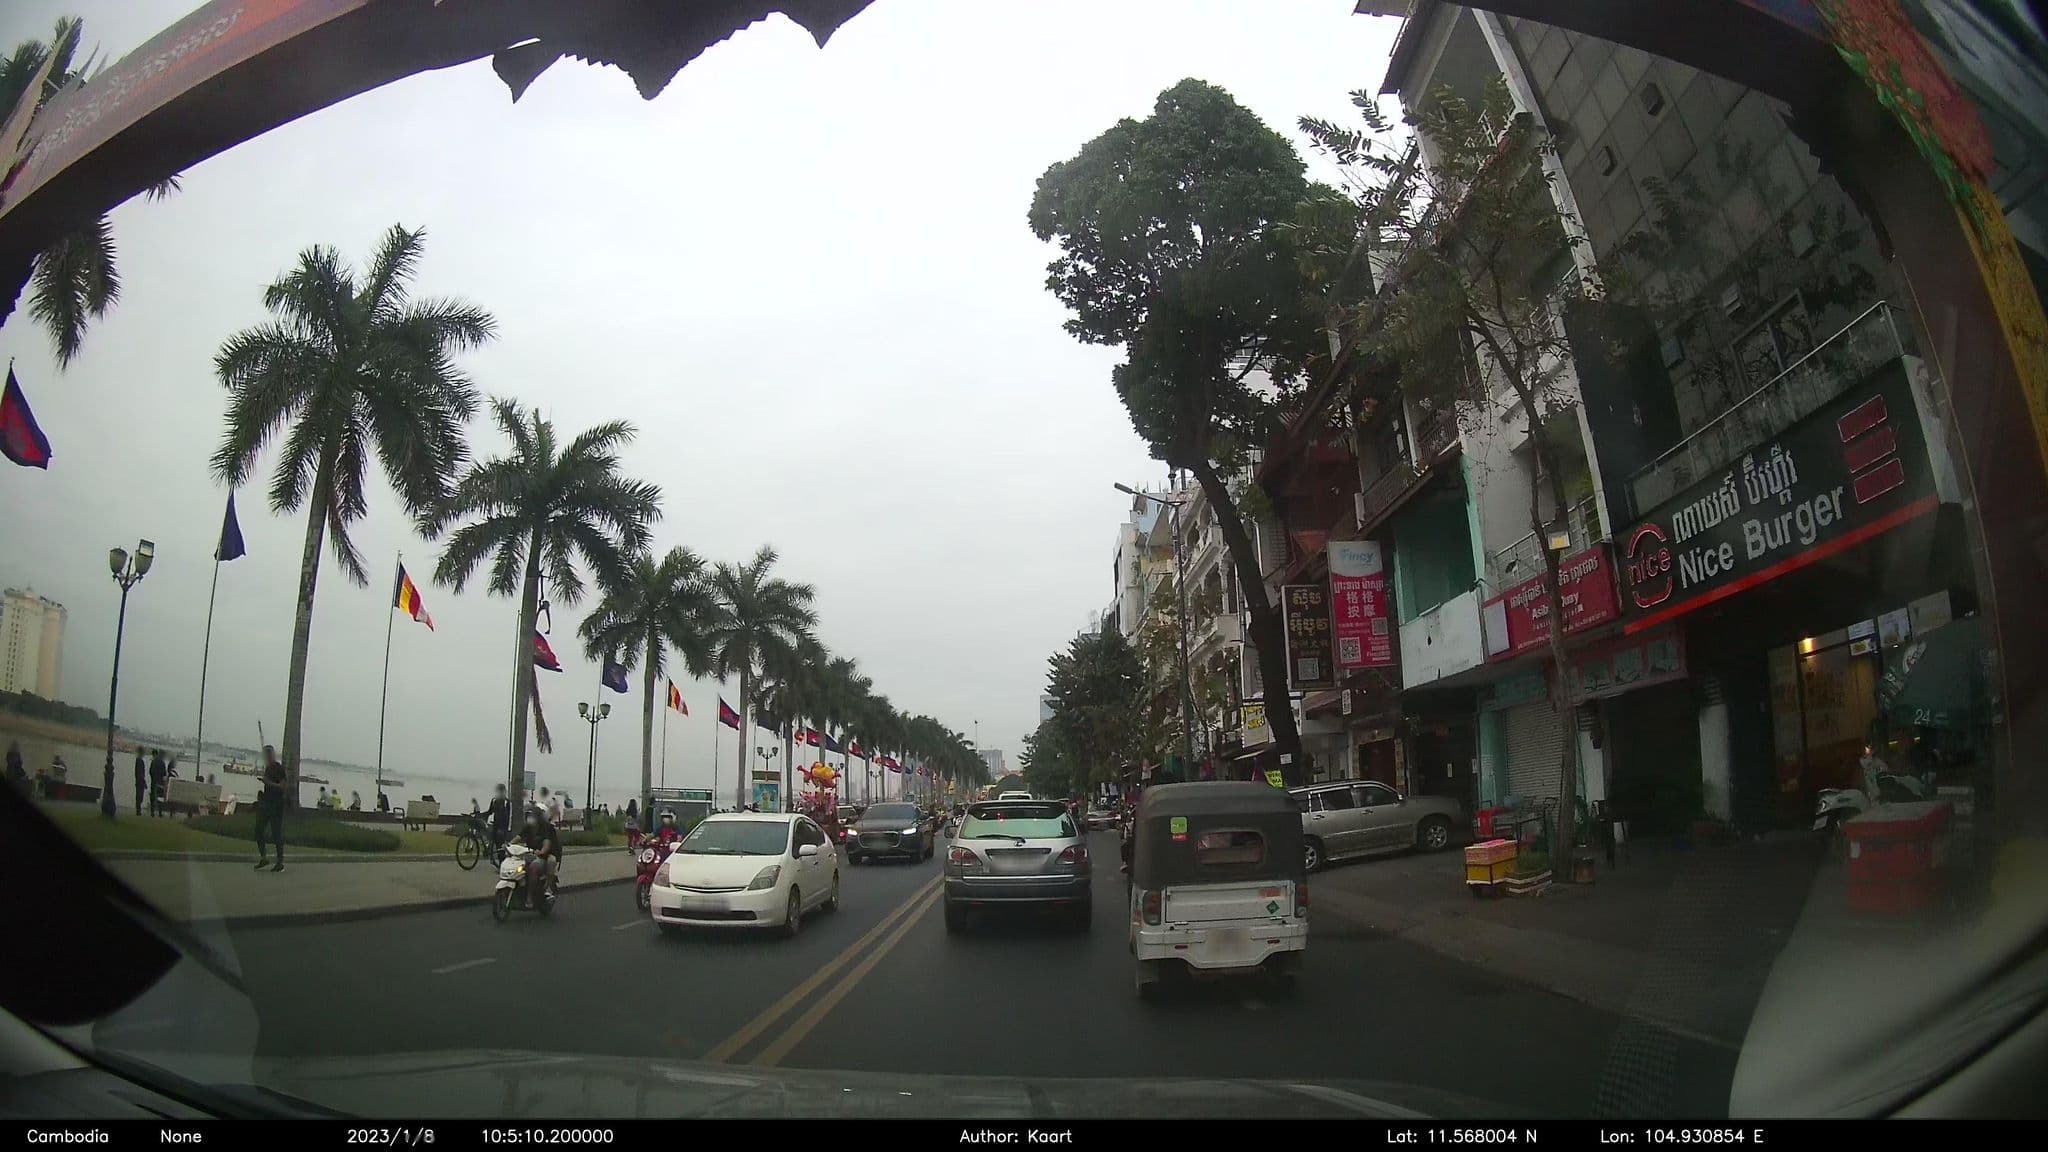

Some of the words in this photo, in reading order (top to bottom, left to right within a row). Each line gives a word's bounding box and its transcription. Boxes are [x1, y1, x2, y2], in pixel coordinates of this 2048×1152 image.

[1627, 546, 1673, 586] nice
[1678, 541, 1735, 589] Nice
[1742, 485, 1844, 561] Burger
